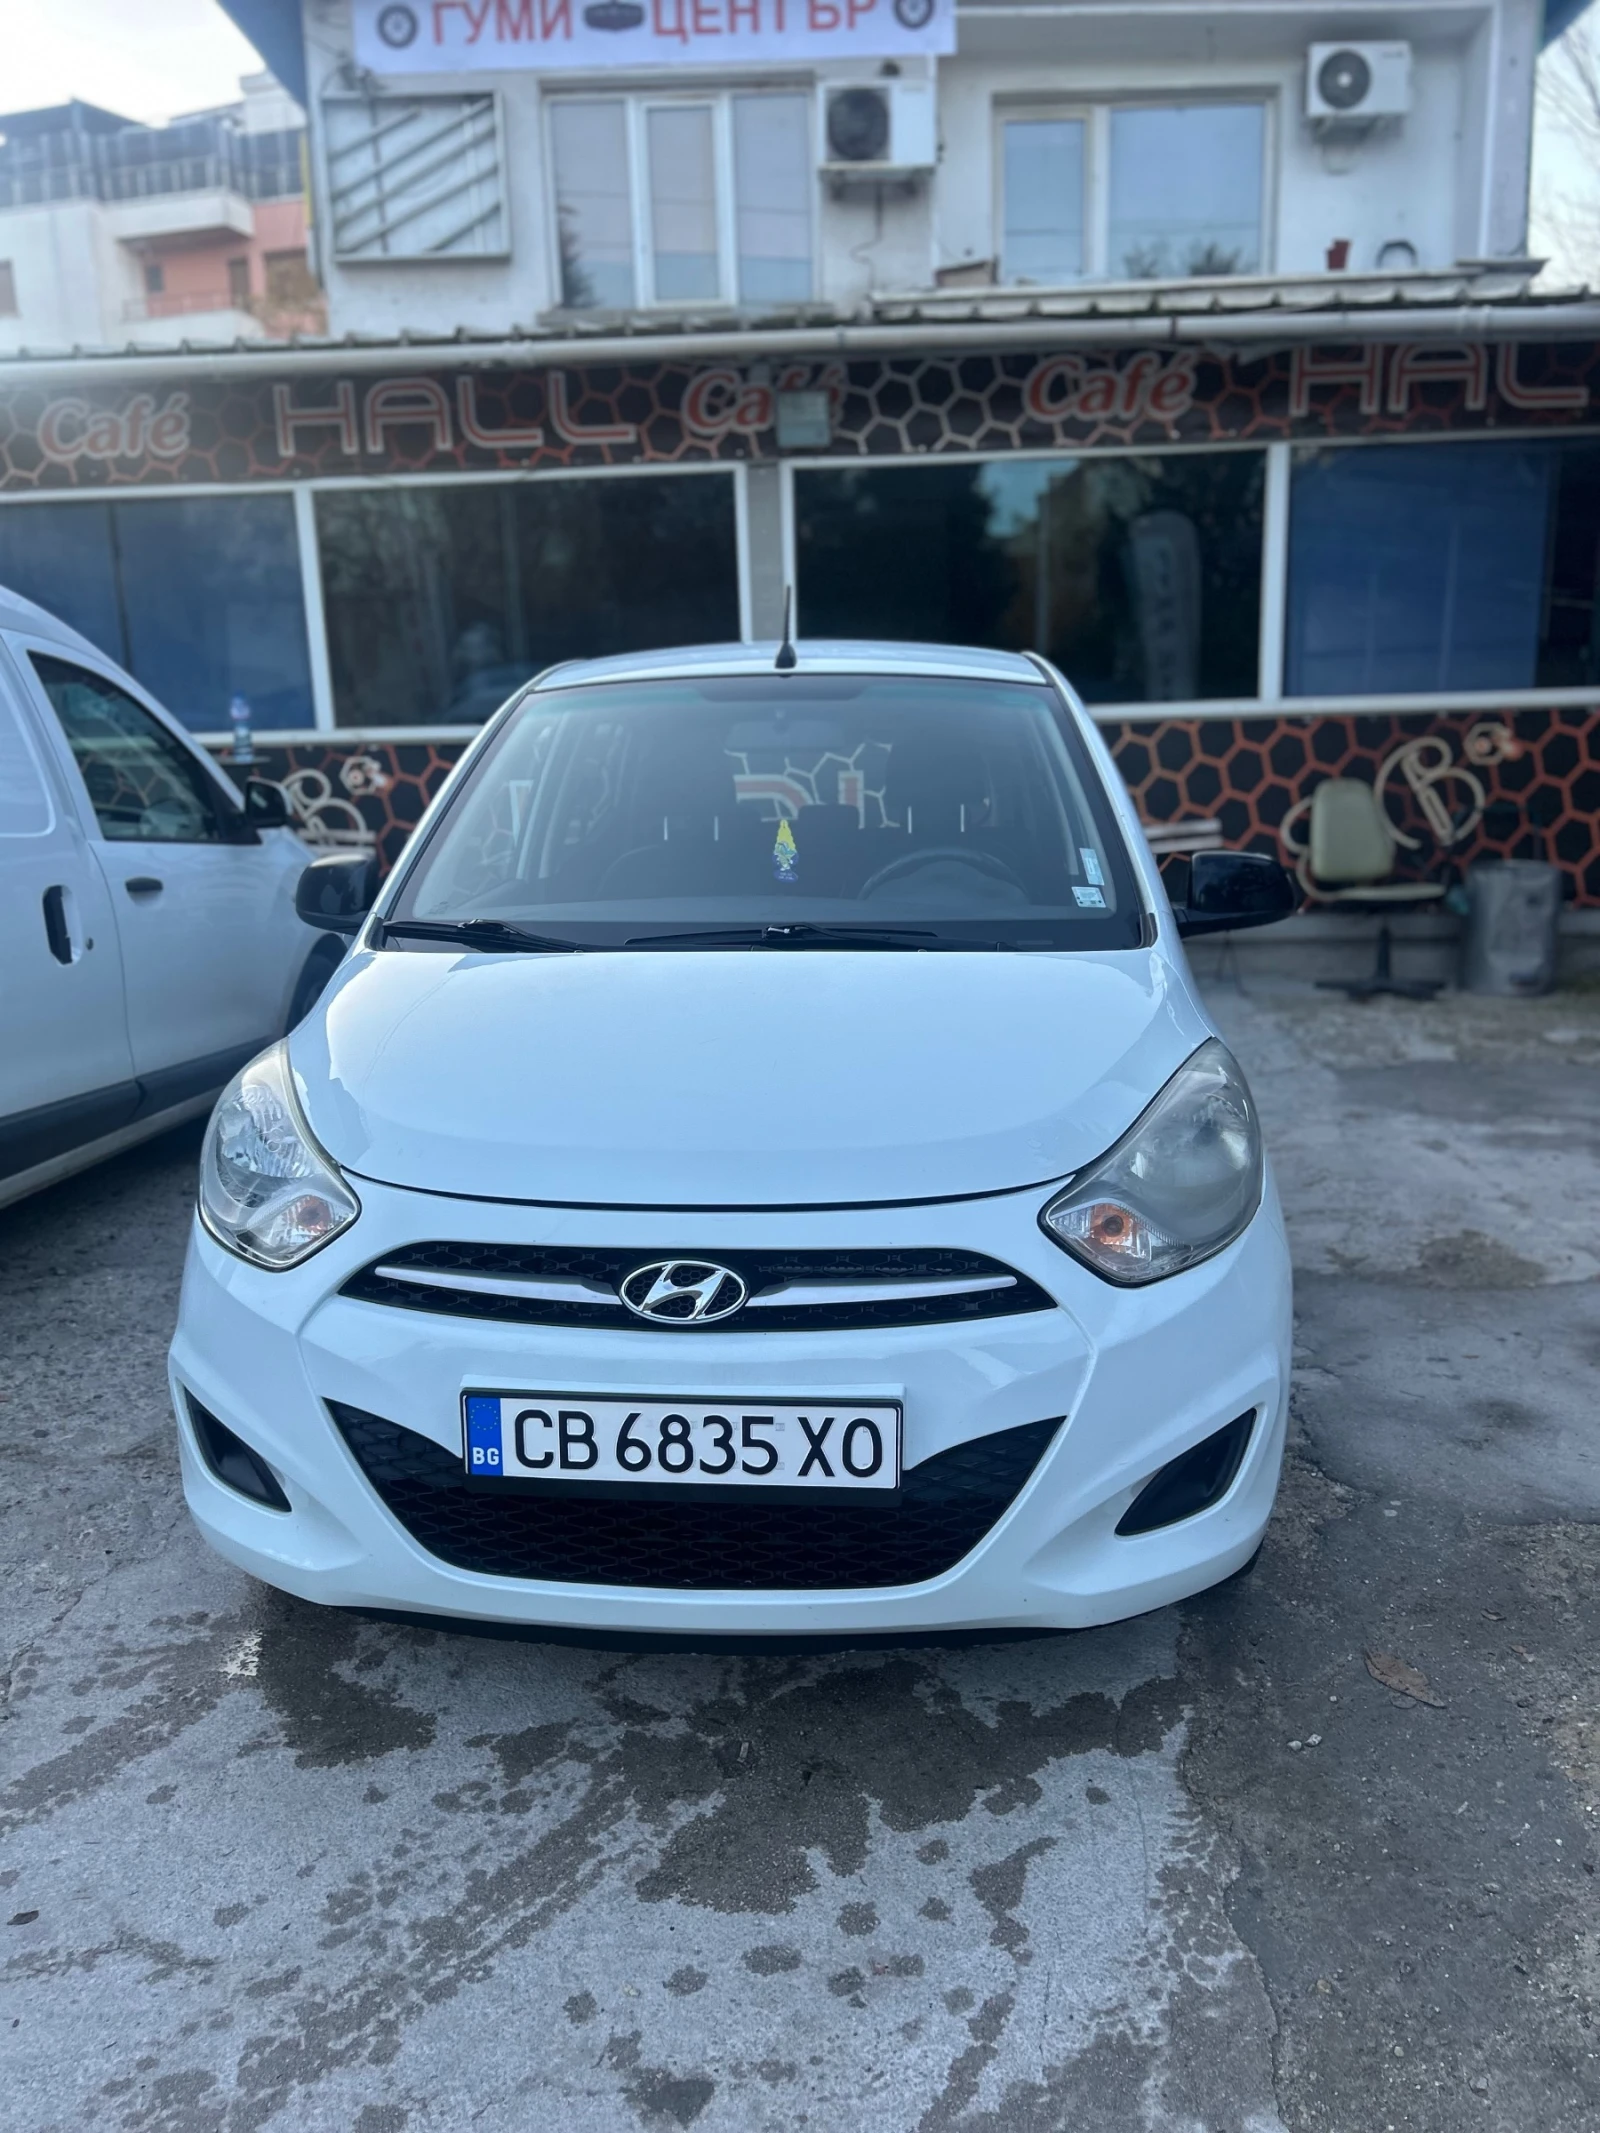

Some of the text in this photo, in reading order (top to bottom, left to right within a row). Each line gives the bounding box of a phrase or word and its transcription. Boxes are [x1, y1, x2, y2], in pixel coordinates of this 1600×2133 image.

[433, 0, 573, 46] ГУМИ
[273, 371, 638, 456] HALL
[680, 364, 848, 437] Ca
[1021, 348, 1198, 424] Café
[37, 391, 191, 462] Café
[472, 1446, 500, 1466] BG
[513, 1408, 883, 1478] CB 6835 XO
